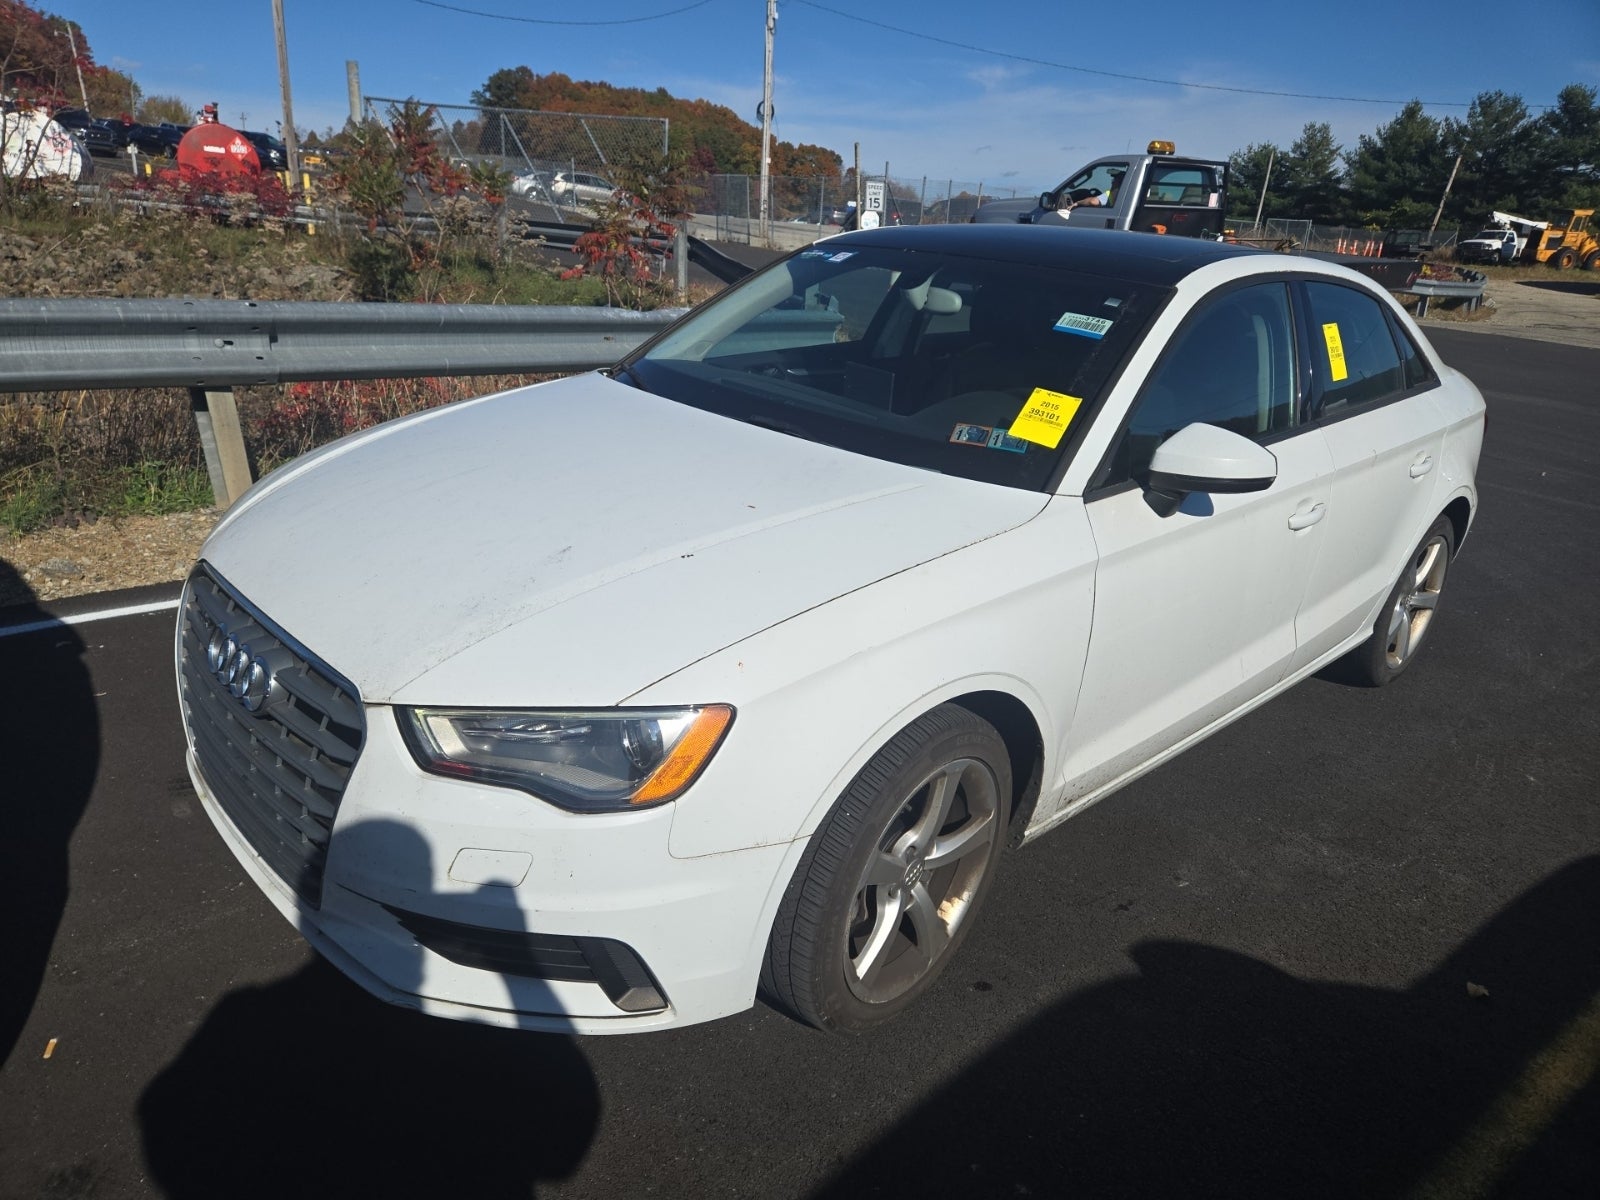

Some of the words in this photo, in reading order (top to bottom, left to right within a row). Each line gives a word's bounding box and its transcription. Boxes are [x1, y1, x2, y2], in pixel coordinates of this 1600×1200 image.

[869, 197, 880, 208] 15
[1040, 401, 1060, 411] 2015
[1028, 408, 1060, 422] 393101
